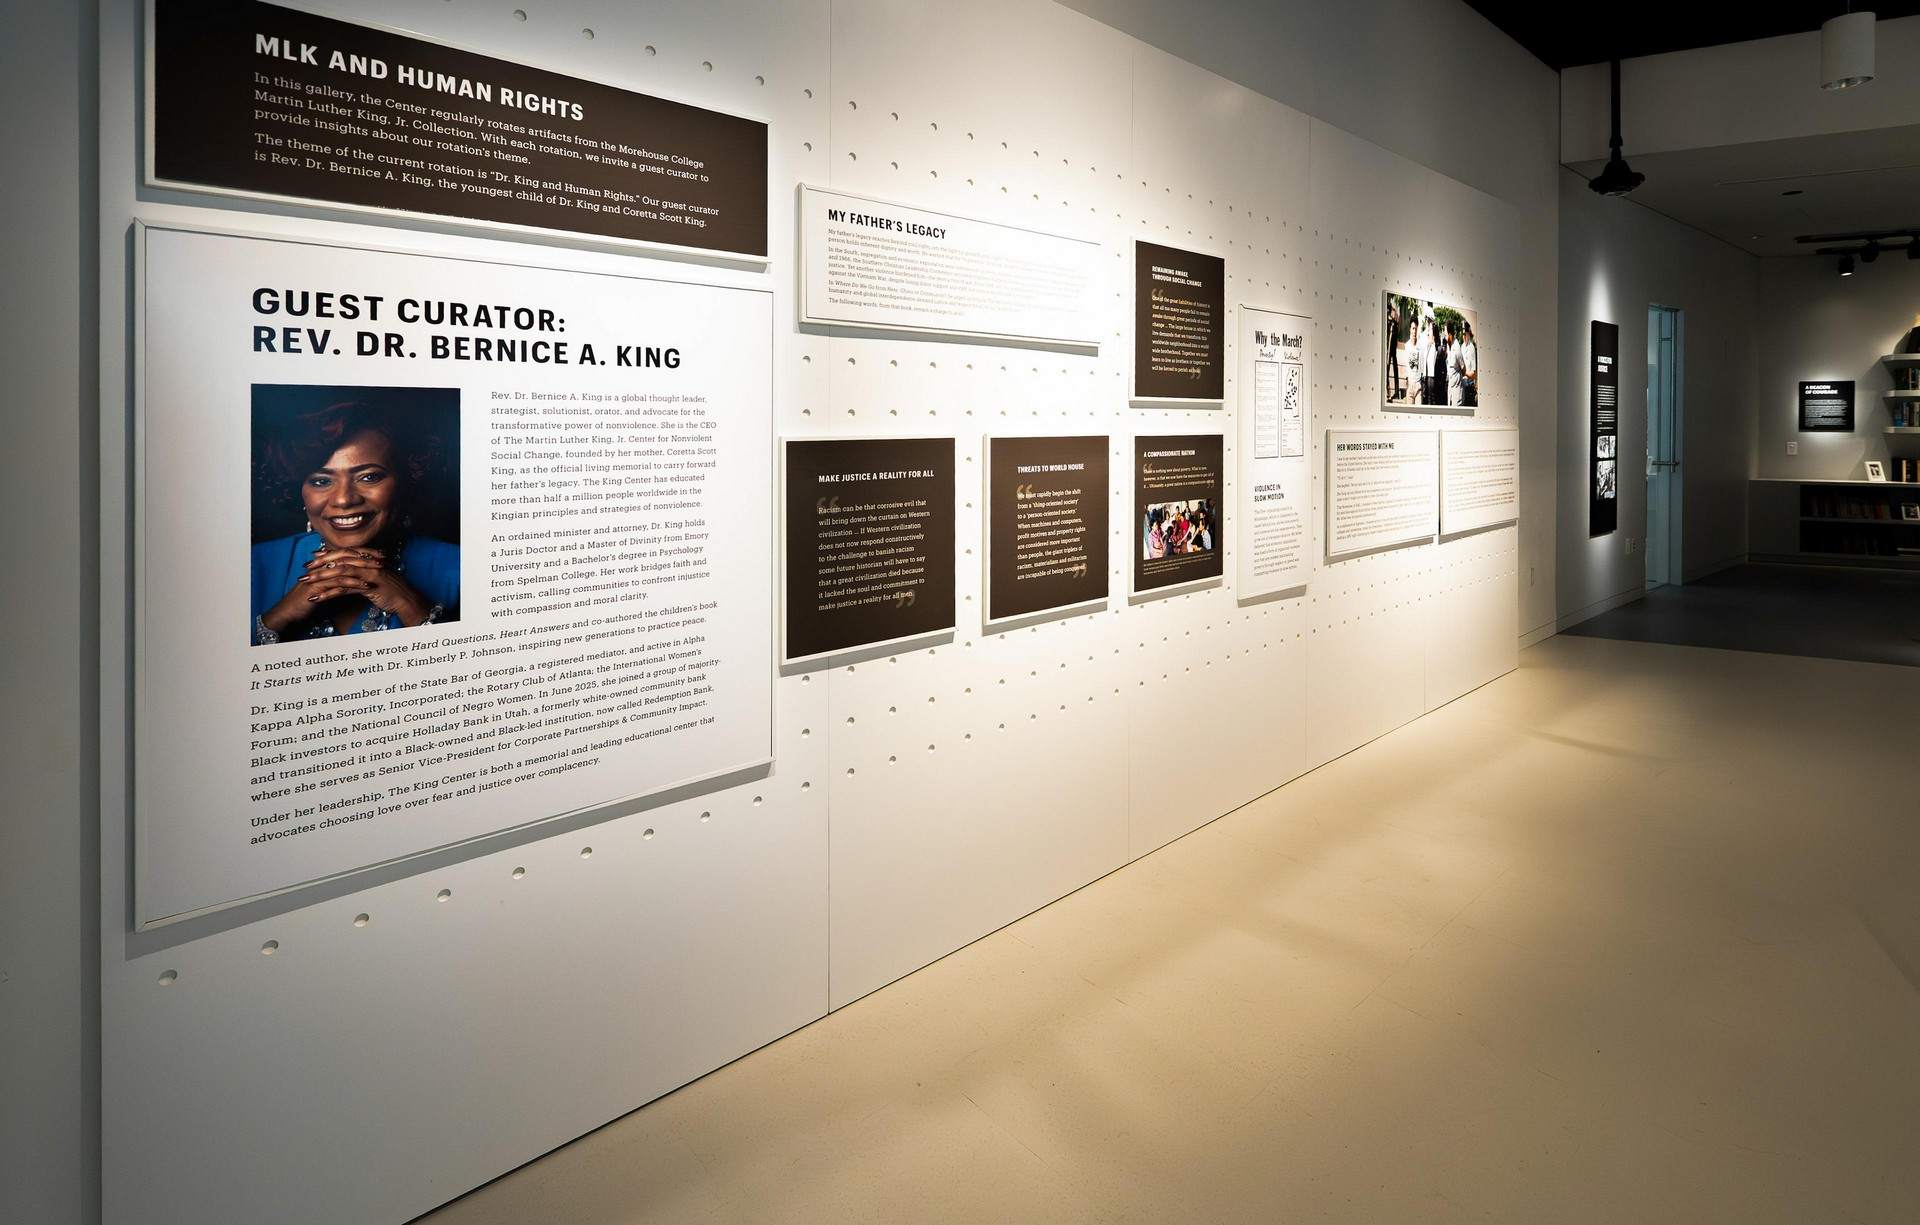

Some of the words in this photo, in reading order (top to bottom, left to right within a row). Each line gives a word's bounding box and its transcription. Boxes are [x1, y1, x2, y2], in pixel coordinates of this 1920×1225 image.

[255, 33, 318, 66] MLK
[328, 50, 388, 79] AND
[398, 64, 491, 102] HUMAN
[500, 87, 583, 121] RIGHTS
[254, 109, 310, 126] provide
[314, 117, 368, 136] insights
[372, 128, 408, 143] about
[412, 137, 433, 147] our
[436, 141, 490, 157] rotation's
[493, 149, 531, 164] theme.
[255, 72, 269, 84] In
[274, 76, 301, 90] this
[305, 84, 356, 102] gallery,
[360, 93, 382, 106] the
[385, 98, 427, 114] Center
[430, 108, 484, 127] regularly
[487, 120, 525, 134] rotates
[528, 128, 572, 143] artifacts
[574, 135, 598, 148] from
[600, 140, 616, 152] the
[618, 144, 669, 162] Morehouse
[670, 154, 704, 169] College
[255, 89, 303, 108] Martin
[308, 99, 352, 117] Luther
[357, 108, 391, 125] King,
[395, 116, 408, 127] Jr.
[412, 119, 477, 140] Collection.
[480, 131, 507, 145] With
[510, 139, 536, 151] each
[538, 144, 582, 160] rotation,
[584, 153, 600, 162] we
[601, 154, 629, 168] invite
[638, 163, 664, 174] guest
[666, 168, 698, 180] curator
[700, 174, 709, 182] to
[828, 209, 846, 222] MY
[850, 213, 902, 232] FATHER'S
[906, 223, 946, 239] LEGACY
[1152, 266, 1174, 275] REMAINING
[252, 287, 384, 321] GUEST
[397, 298, 565, 333] CURATOR:
[253, 325, 341, 355] REV.
[356, 330, 416, 358] DR.
[431, 335, 568, 364] BERNICE
[578, 343, 606, 366] A.
[616, 345, 680, 369] KING
[1255, 330, 1267, 347] Why
[1271, 332, 1280, 346] the
[1282, 333, 1302, 348] March?
[491, 421, 562, 430] transformative
[606, 421, 658, 429] nonviolence.
[818, 474, 840, 483] MAKE
[841, 472, 871, 482] JUSTICE
[872, 472, 878, 480] A
[878, 471, 907, 480] REALITY
[908, 470, 921, 478] FOR
[922, 469, 934, 477] ALL
[1017, 465, 1041, 474] THREATS
[1254, 484, 1275, 492] VIOLENCE
[818, 506, 841, 514] Racism
[818, 542, 834, 551] does
[860, 536, 884, 546] respond
[884, 532, 924, 543] constructively
[250, 681, 260, 690] It
[263, 676, 301, 688] Starts
[305, 670, 332, 682] with
[336, 668, 354, 678] Me
[357, 663, 384, 674] with
[387, 661, 403, 670] Dr.
[406, 653, 457, 668] Kimberly
[459, 651, 468, 660] P.
[471, 646, 515, 658] Johnson,
[518, 638, 561, 651] inspiring
[563, 635, 582, 644] new
[584, 627, 635, 642] generations
[647, 621, 680, 632] practice
[682, 617, 708, 627] peace.
[251, 663, 261, 673] A
[265, 657, 301, 671] noted
[305, 653, 348, 665] author,
[351, 649, 372, 659] she
[375, 645, 408, 656] wrote
[411, 639, 438, 651] Hard
[441, 633, 496, 646] Questions,
[499, 628, 527, 639] Heart
[529, 623, 570, 634] Answers
[571, 618, 589, 628] and
[591, 611, 642, 626] co-authored
[644, 610, 658, 618] the
[659, 604, 698, 616] children's
[699, 600, 718, 610] book
[250, 823, 315, 845] advocates
[319, 810, 374, 829] choosing
[377, 804, 402, 815] love
[404, 797, 429, 809] over
[432, 791, 453, 802] fear
[456, 784, 476, 797] and
[478, 778, 512, 793] justice
[514, 772, 536, 783] over
[538, 757, 600, 777] complacency.
